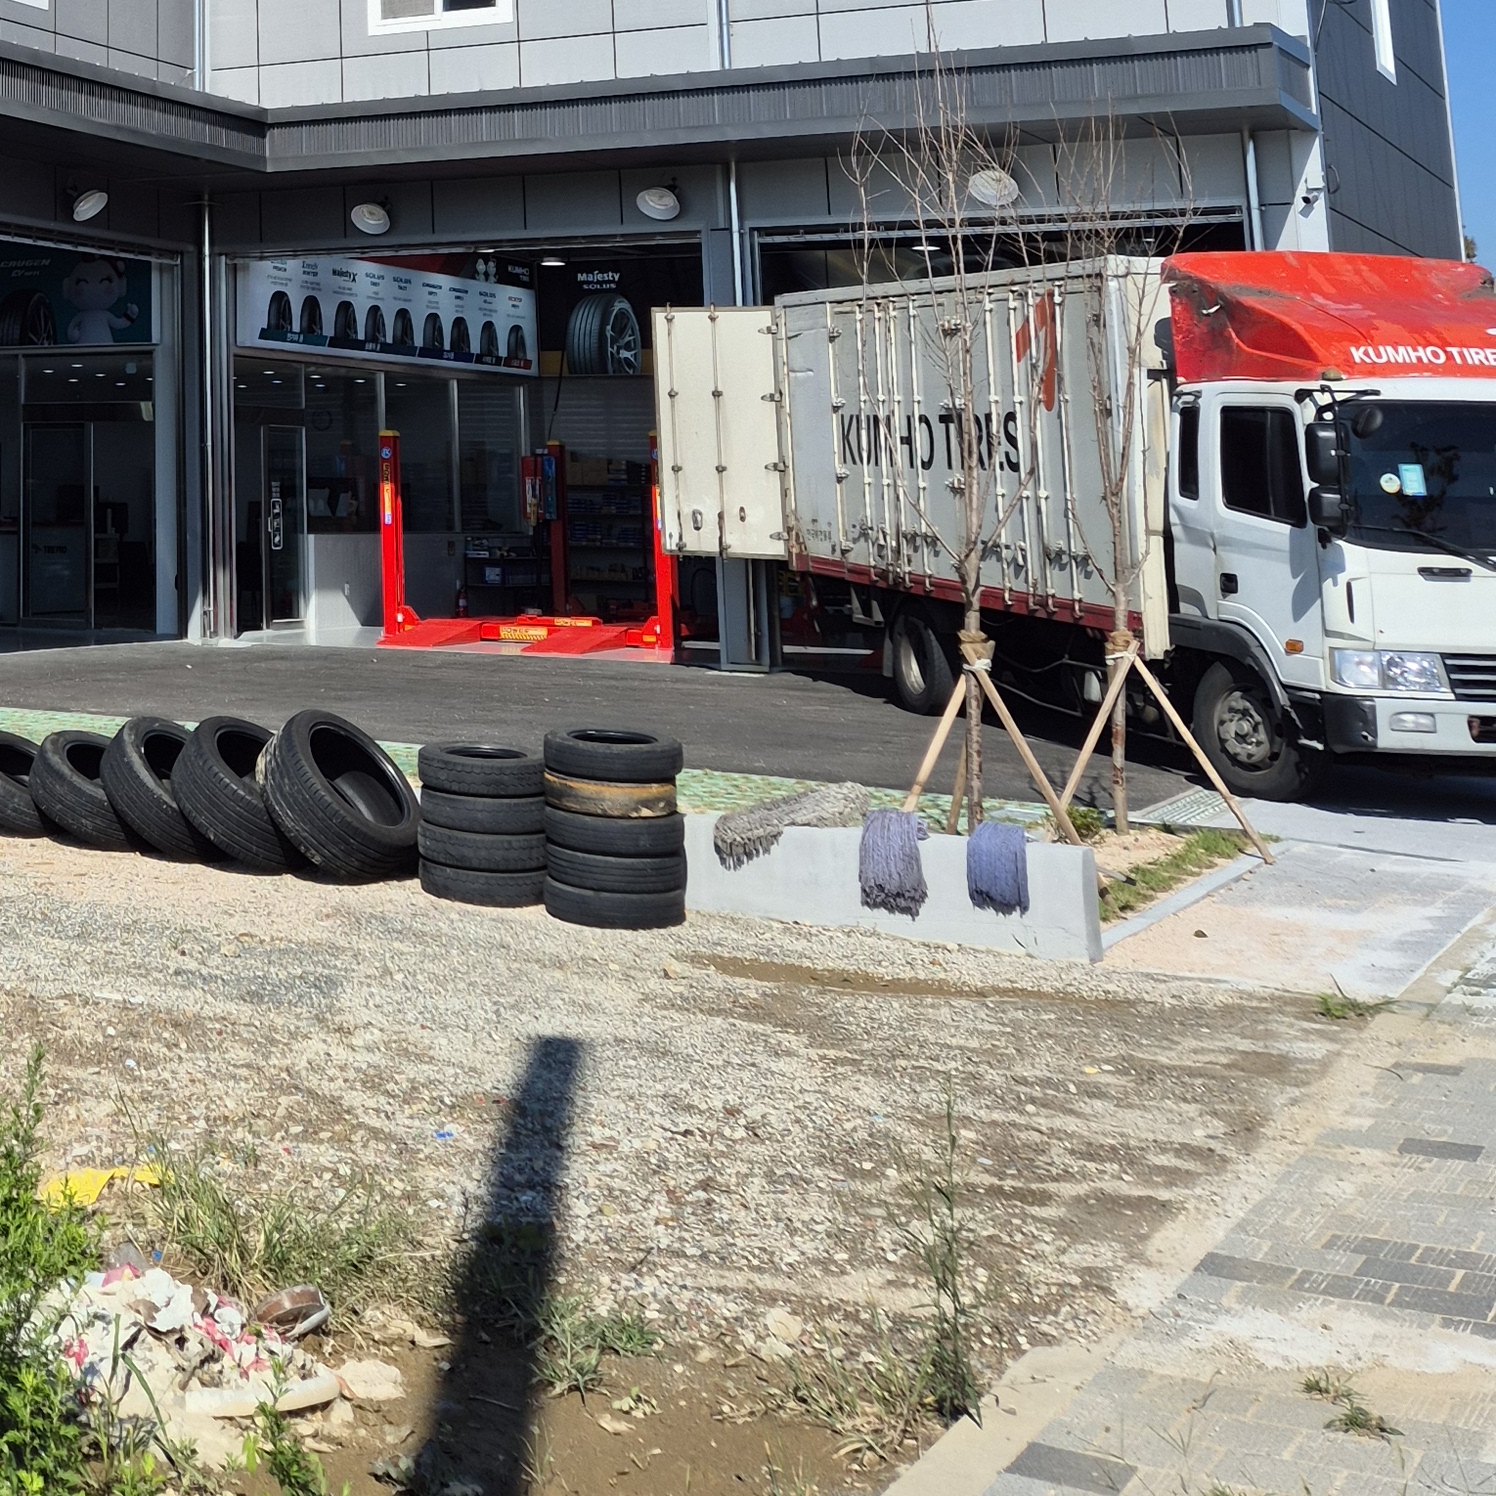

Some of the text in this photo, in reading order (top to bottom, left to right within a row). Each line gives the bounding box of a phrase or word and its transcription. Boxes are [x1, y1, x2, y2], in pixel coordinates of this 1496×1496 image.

[0, 258, 51, 268] CRUGEN
[577, 270, 621, 282] Majesty
[1349, 345, 1447, 365] KUMHO
[840, 413, 935, 471] KUMHO
